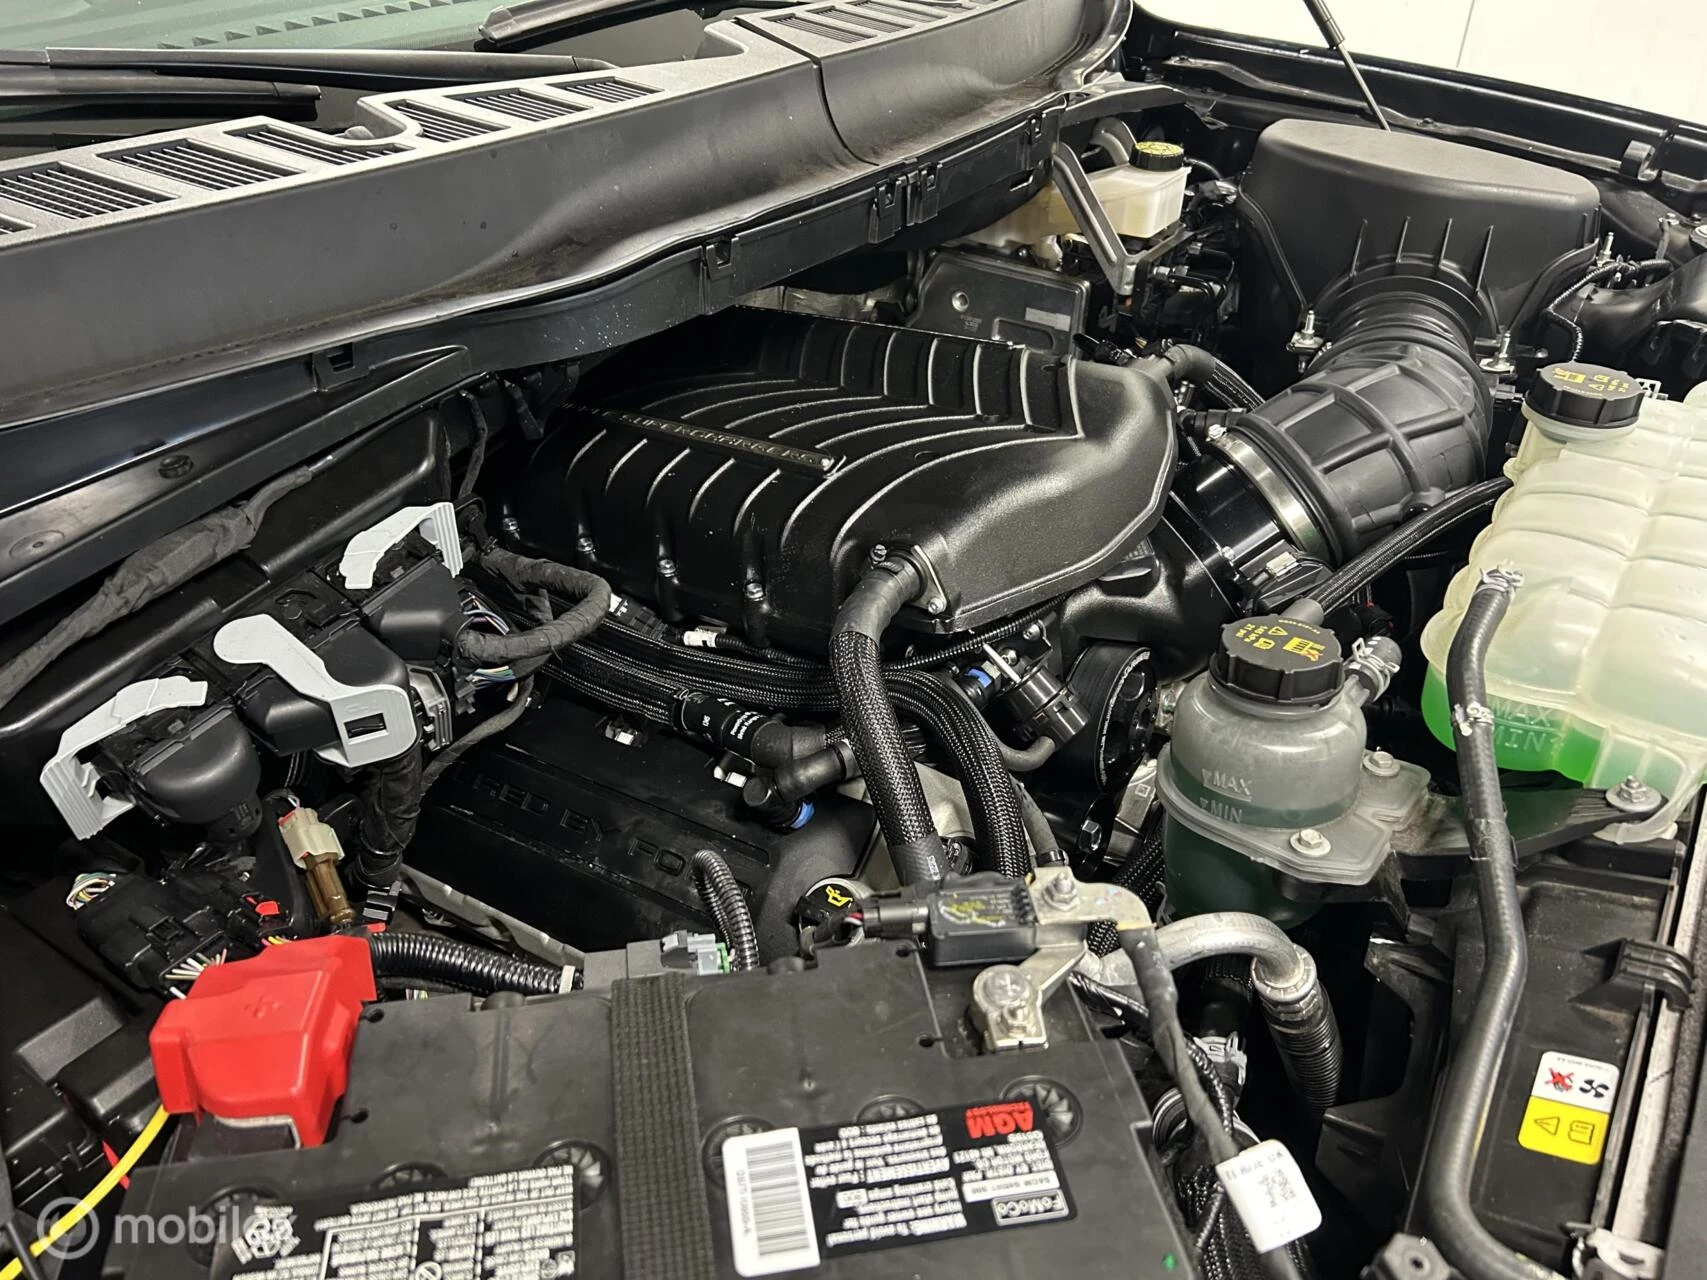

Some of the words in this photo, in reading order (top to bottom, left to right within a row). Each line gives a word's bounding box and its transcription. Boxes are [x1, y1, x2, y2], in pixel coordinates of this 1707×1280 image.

[1212, 769, 1252, 796] MAX
[1209, 799, 1242, 824] MIN
[967, 1110, 1032, 1137] AGM
[997, 1195, 1061, 1217] FoMoCo
